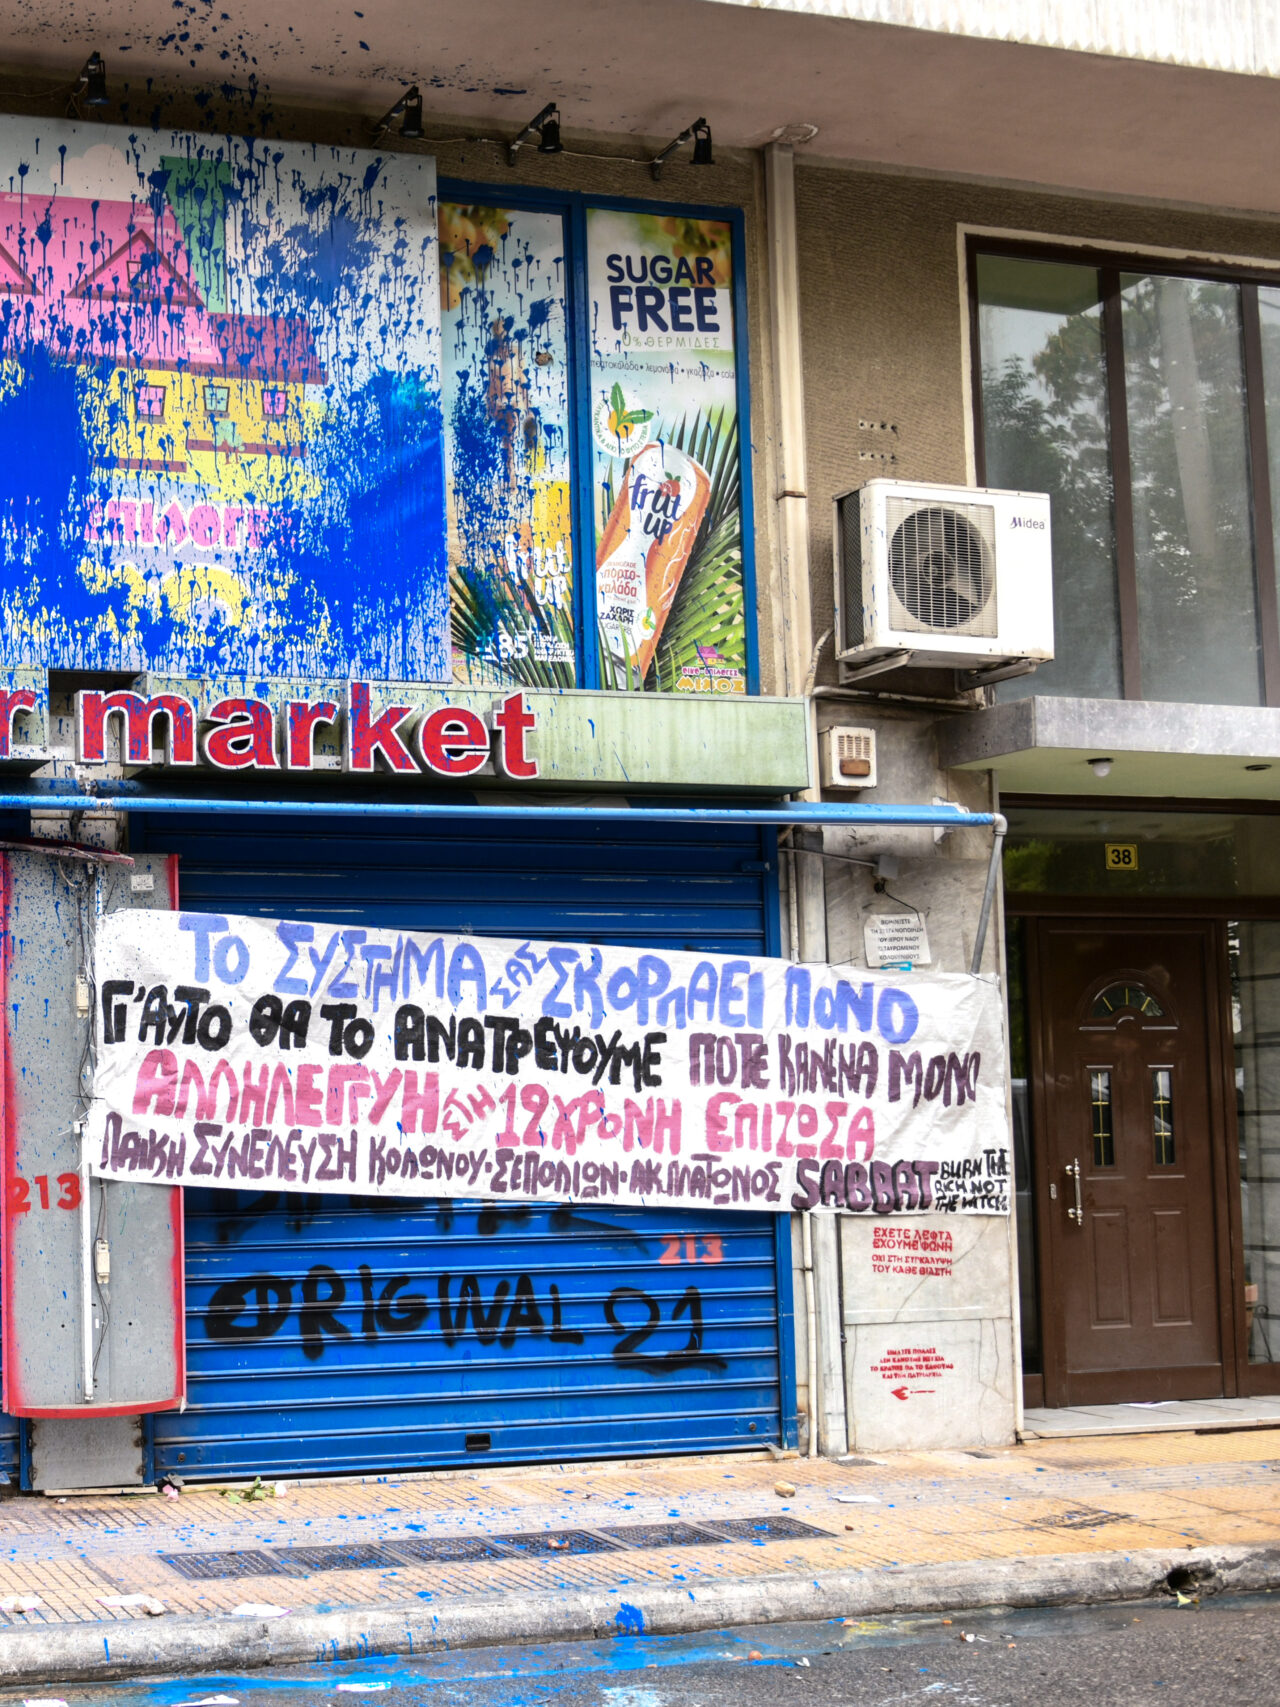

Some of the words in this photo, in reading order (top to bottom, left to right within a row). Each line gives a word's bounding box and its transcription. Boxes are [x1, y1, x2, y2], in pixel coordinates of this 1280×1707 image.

[607, 254, 716, 285] SUGAR
[609, 285, 720, 333] FREE
[645, 337, 720, 349] ΘΕΡΜΙΔΕΣ
[1010, 516, 1045, 529] Midea
[74, 678, 539, 780] market
[1110, 849, 1133, 865] 38
[178, 913, 251, 986] ΤΟ
[272, 920, 488, 1014] ΣΥΣΤΗΜΑ
[784, 966, 921, 1045] ΠΟΝΟ
[248, 993, 312, 1050] ΘΑ
[320, 1002, 376, 1060] ΤΟ
[688, 1031, 771, 1090] ΠΟΤΕ
[940, 1158, 982, 1181] BURN
[7, 1172, 83, 1217] 213
[791, 1158, 939, 1214] SABBAT
[970, 1178, 1008, 1195] NOT
[872, 1238, 919, 1251] ΕΧΟΥΜΕ
[920, 1240, 953, 1253] ΦΩΝΗ
[873, 1227, 911, 1239] ΕΧΕΤΕ
[914, 1229, 953, 1241] ΛΕΦΤΑ
[658, 1233, 724, 1265] 213
[871, 1254, 885, 1262] ΟΧΙ
[887, 1254, 903, 1263] ΣΤΗ
[904, 1255, 953, 1266] ΣΥΓΚΑΛΥΨΗ
[872, 1264, 890, 1273] ΤΟΥ
[892, 1265, 918, 1275] ΚΑΘΕ
[919, 1266, 952, 1277] ΒΙΑΣΤΗ
